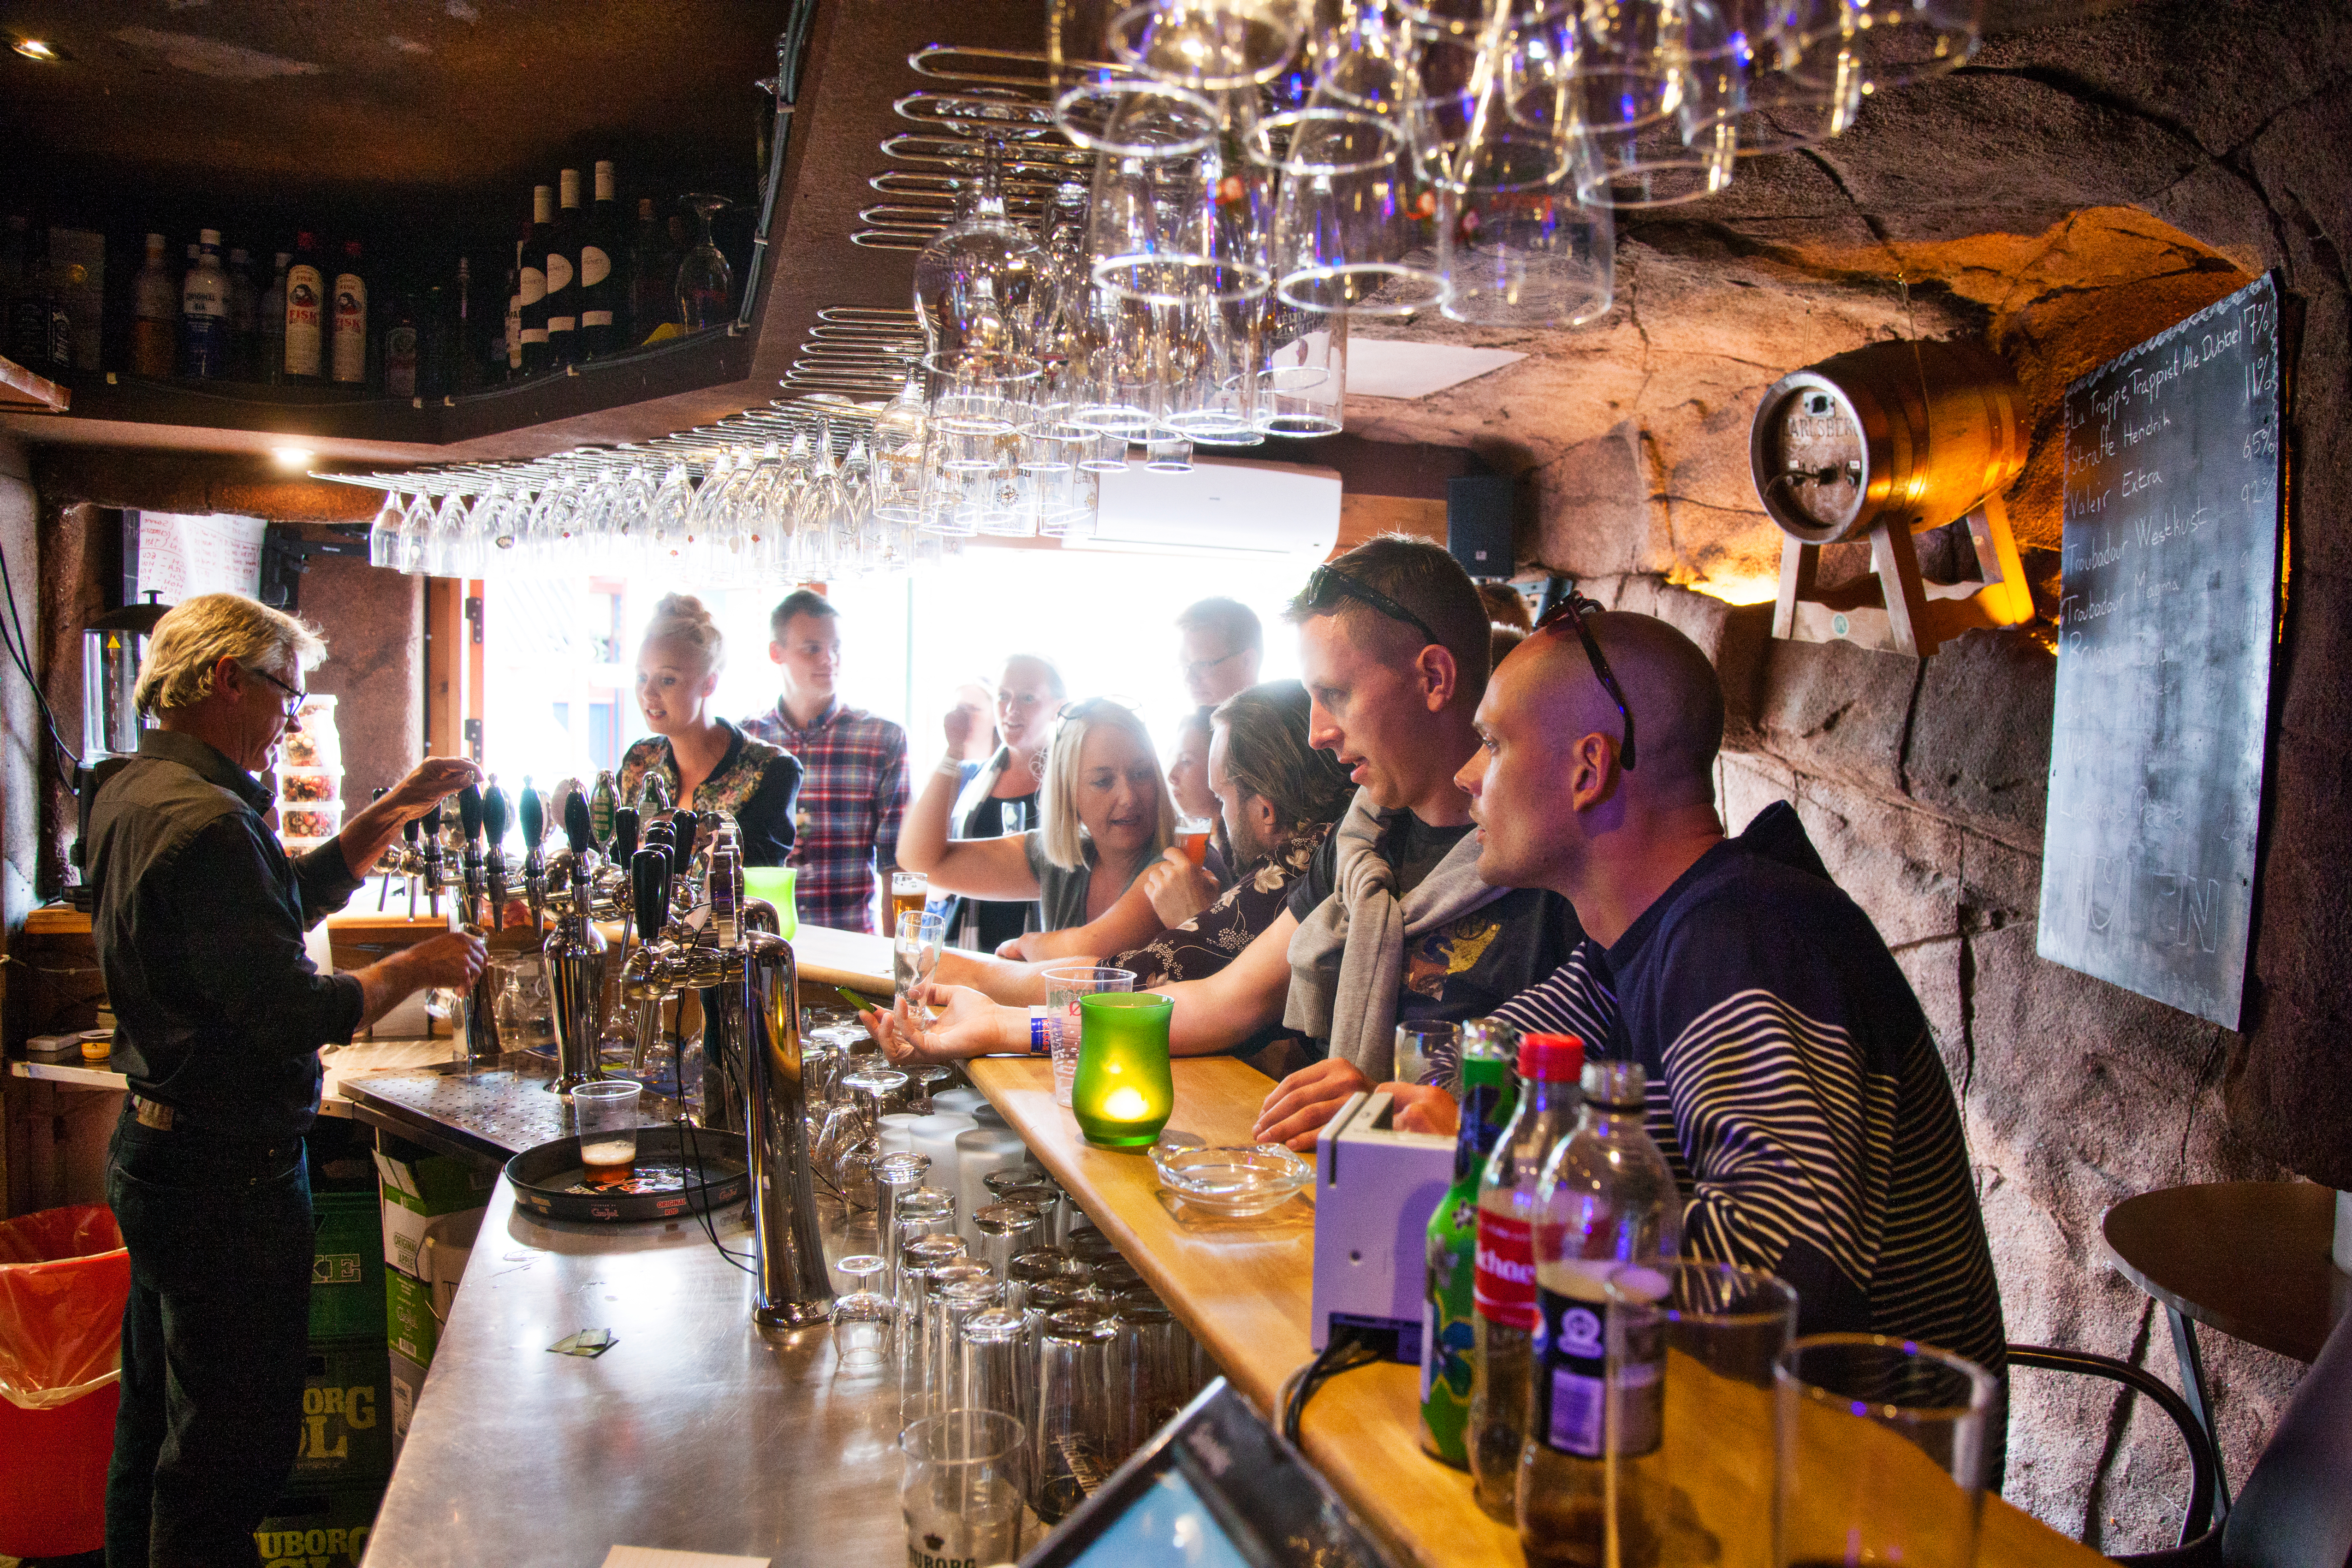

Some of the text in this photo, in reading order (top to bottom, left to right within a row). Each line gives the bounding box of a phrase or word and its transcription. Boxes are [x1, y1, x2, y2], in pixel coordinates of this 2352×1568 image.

[289, 309, 317, 321] FISK
[2070, 404, 2086, 429] La
[2129, 348, 2179, 404] Trappist
[2181, 345, 2199, 377] Ale
[2201, 317, 2242, 362] Dubbel
[2070, 485, 2110, 519] Valeir
[2122, 468, 2163, 499] Extra
[2068, 530, 2127, 576] Troubadour
[2135, 496, 2209, 549] Westkust
[2064, 571, 2180, 625] Troubadour Magma
[656, 1198, 686, 1208] ORIGINAL
[664, 1207, 679, 1216] RØD
[398, 1253, 414, 1269] APPLE
[303, 1386, 376, 1429] ORG
[253, 1526, 370, 1566] UBOR
